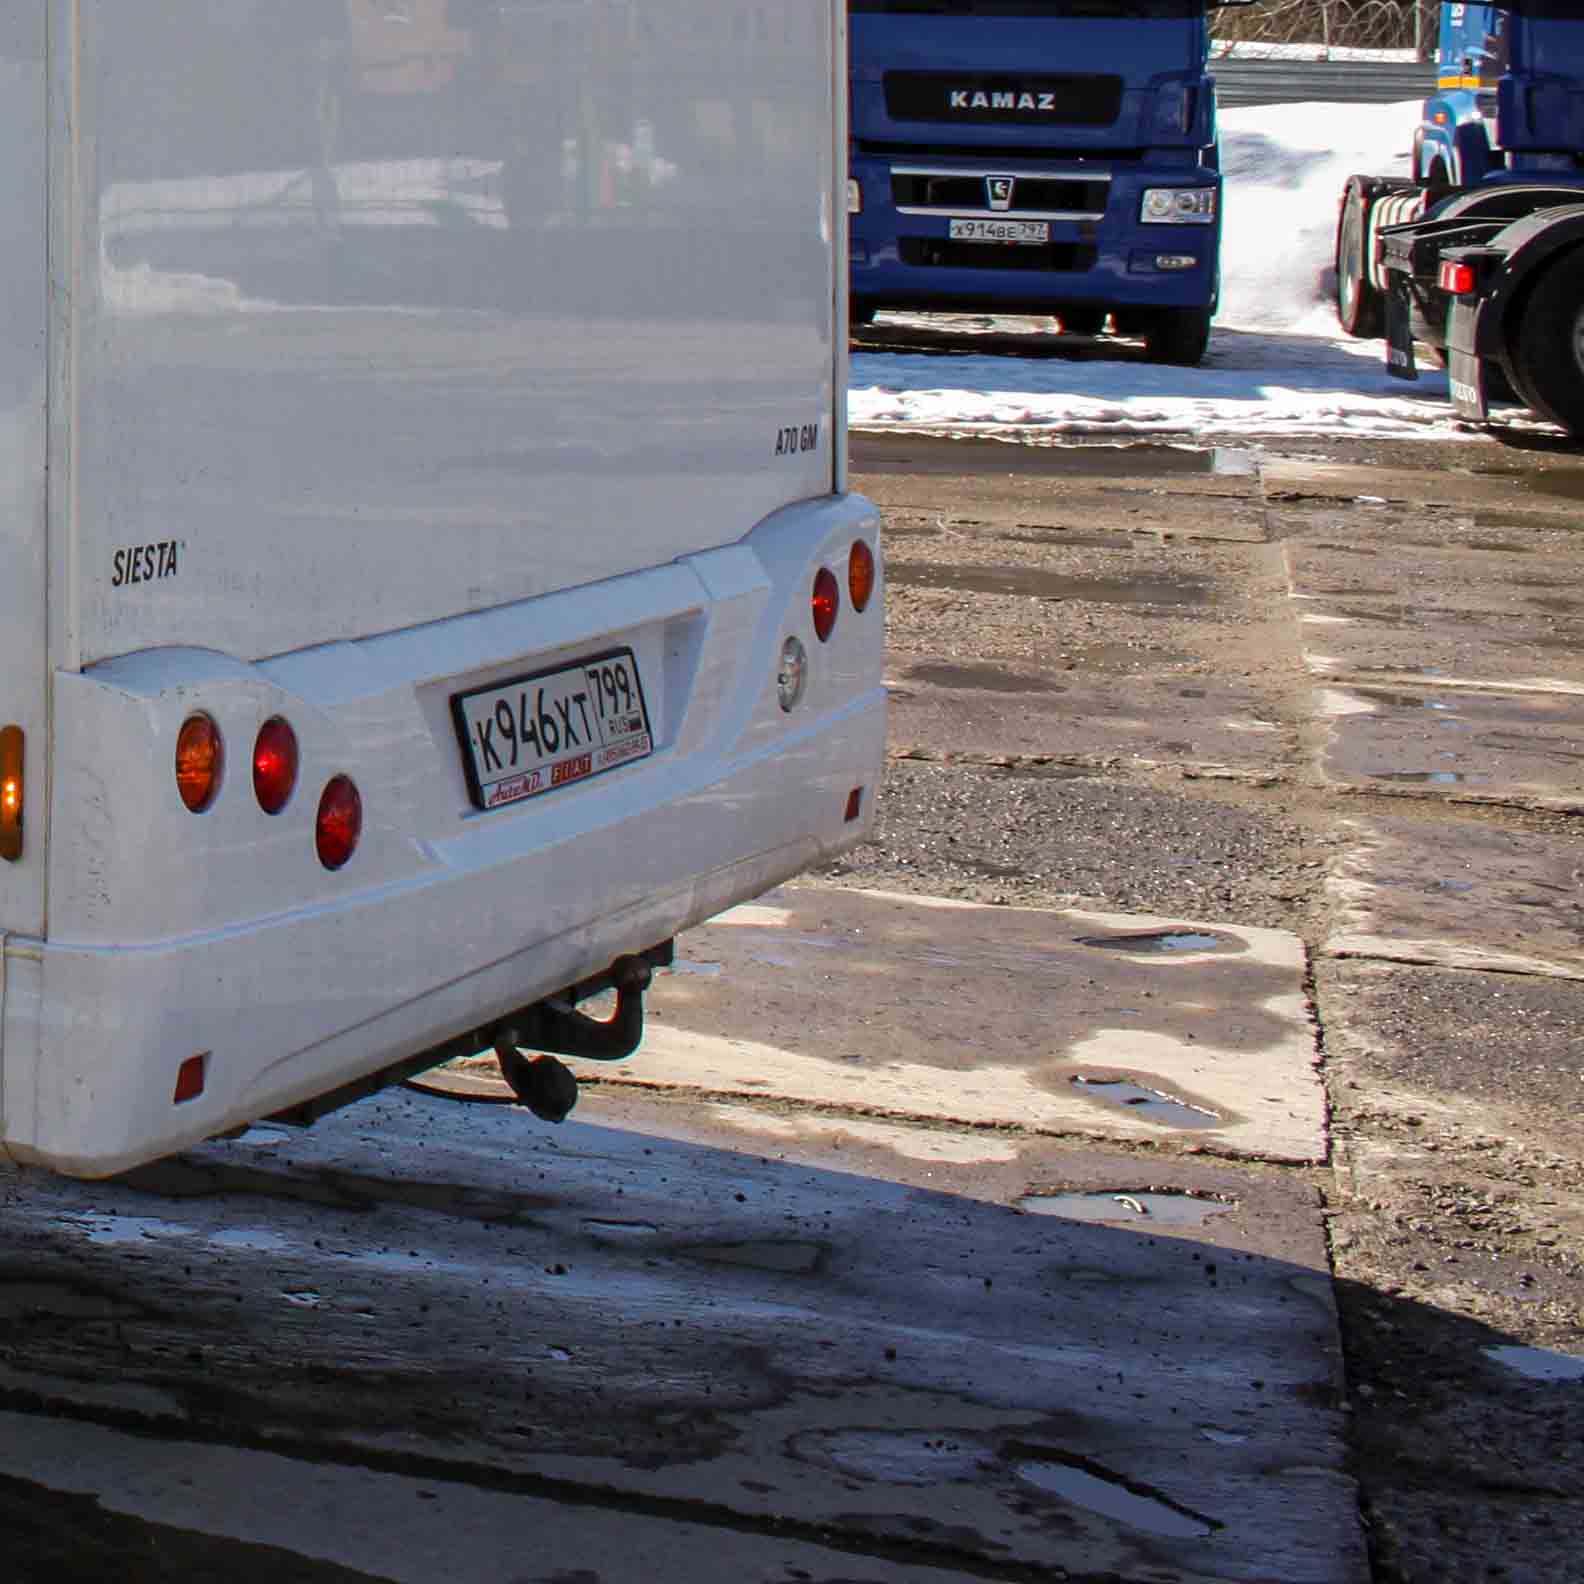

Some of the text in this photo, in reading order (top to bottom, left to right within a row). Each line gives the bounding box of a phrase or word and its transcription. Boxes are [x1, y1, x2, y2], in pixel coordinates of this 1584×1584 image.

[950, 91, 1055, 110] KAMAZ
[112, 540, 177, 587] SIESTA
[588, 663, 631, 719] 799
